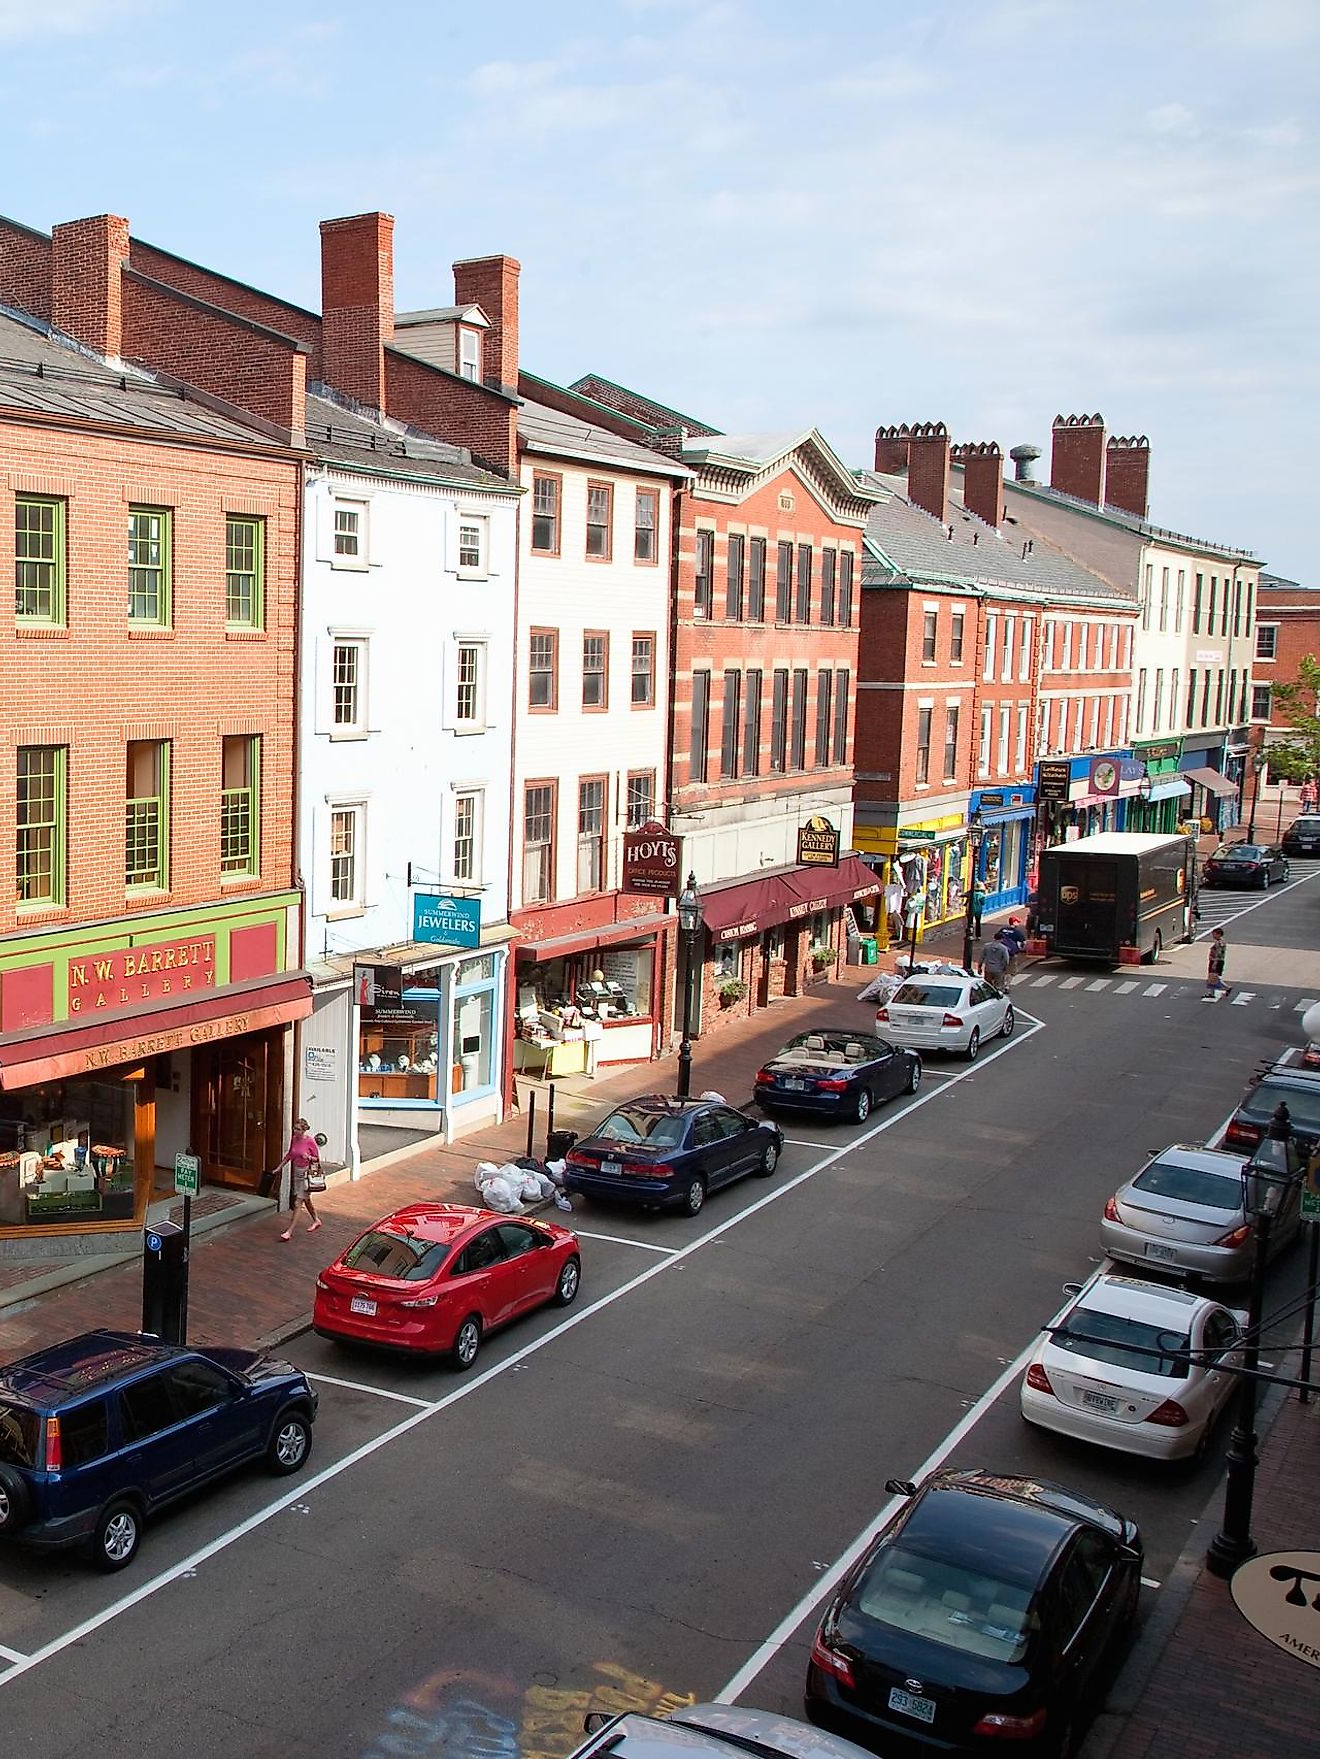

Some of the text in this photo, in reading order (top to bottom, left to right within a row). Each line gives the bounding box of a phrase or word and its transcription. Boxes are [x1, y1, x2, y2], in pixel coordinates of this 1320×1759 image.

[801, 832, 835, 842] KENNEDY
[801, 841, 834, 851] GALLERY
[418, 915, 476, 933] JEWELERS
[124, 941, 214, 978] BARRETT
[71, 970, 214, 1012] GALLERY
[119, 1032, 183, 1061] BARRETT
[190, 1016, 250, 1043] GALLERY
